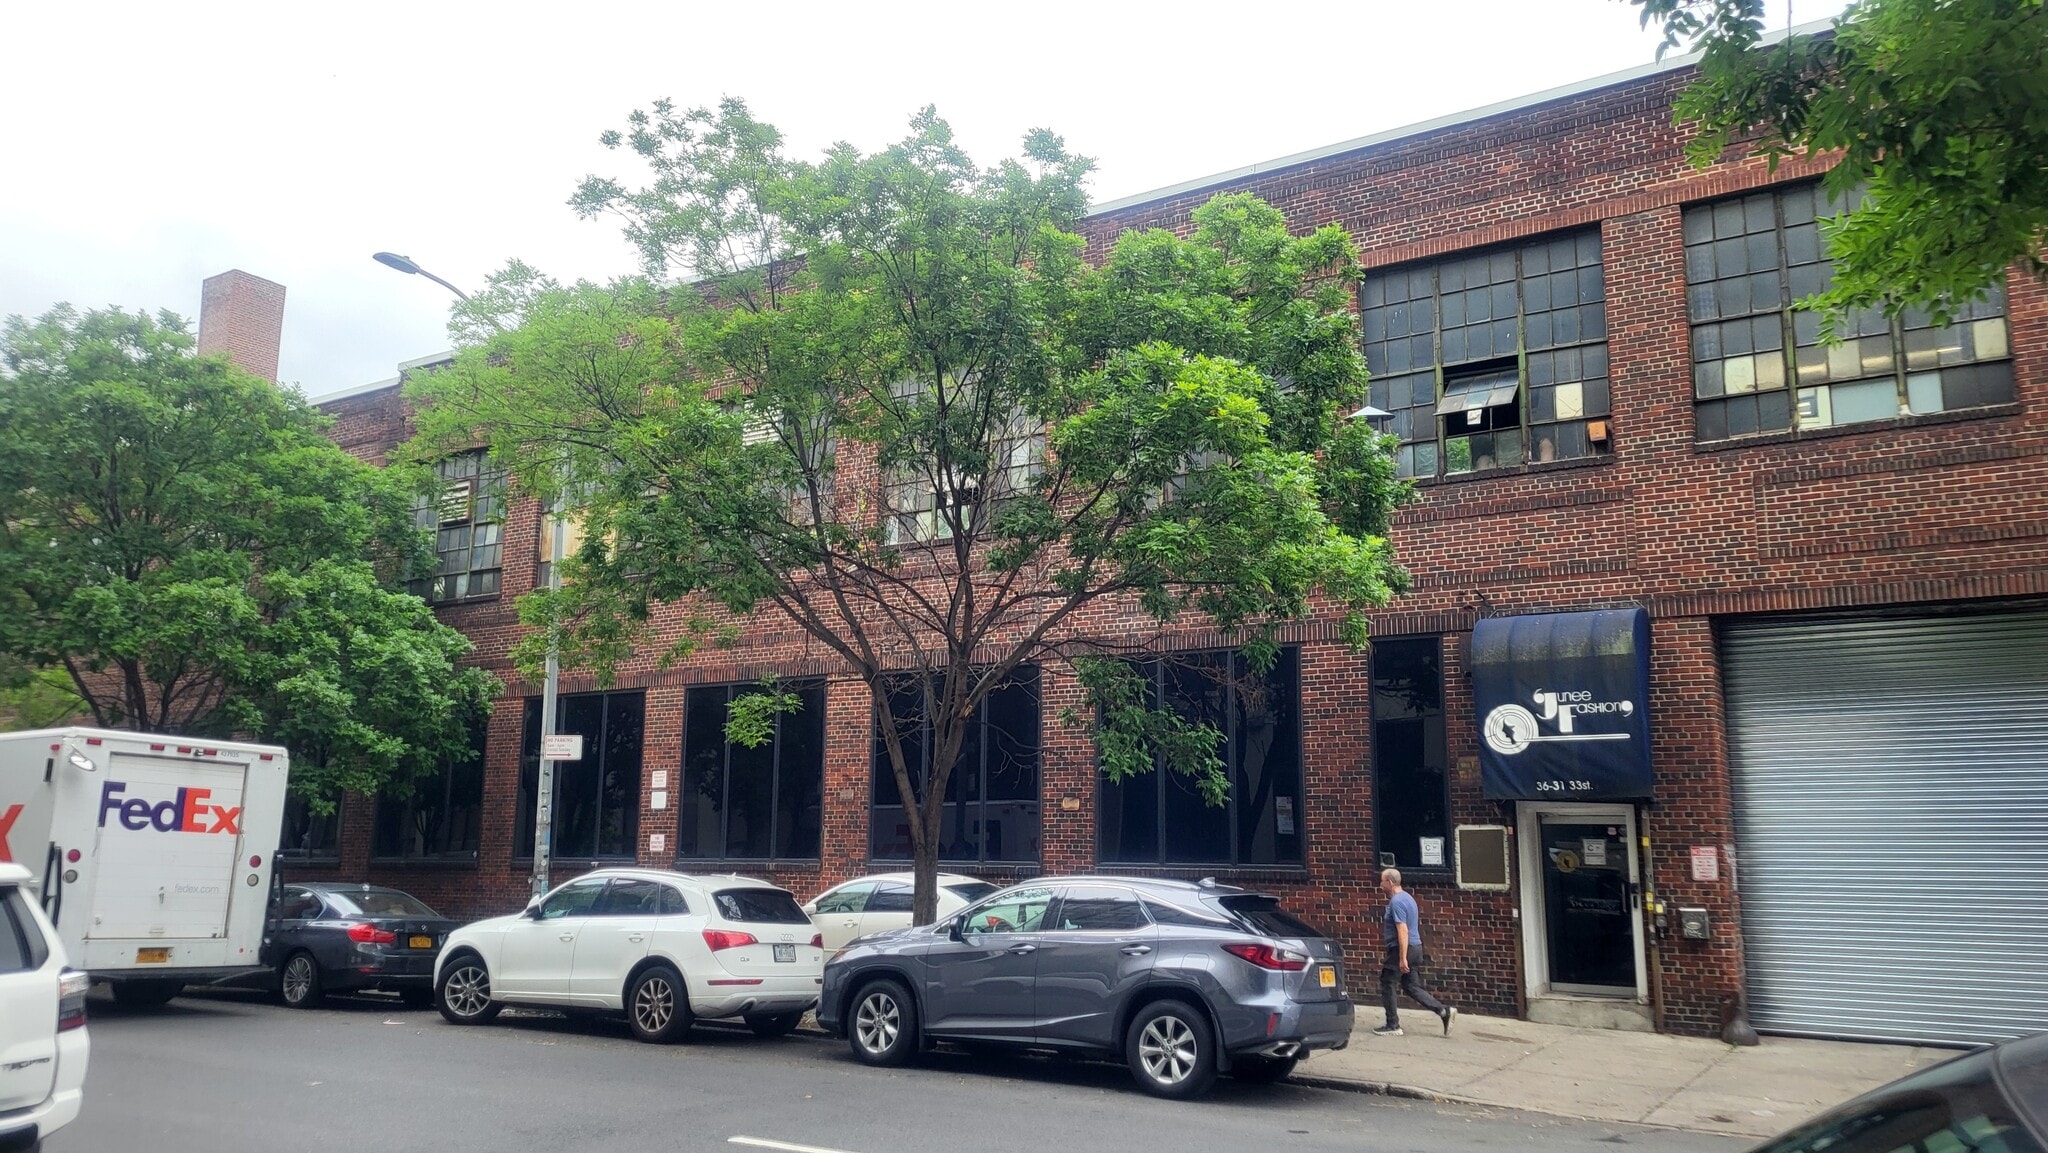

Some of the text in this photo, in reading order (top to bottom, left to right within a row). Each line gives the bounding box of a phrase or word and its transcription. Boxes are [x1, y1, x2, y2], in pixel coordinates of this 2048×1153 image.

[1536, 781, 1565, 791] 36-31
[98, 780, 244, 835] FedEx
[174, 883, 220, 896] fedex.com
